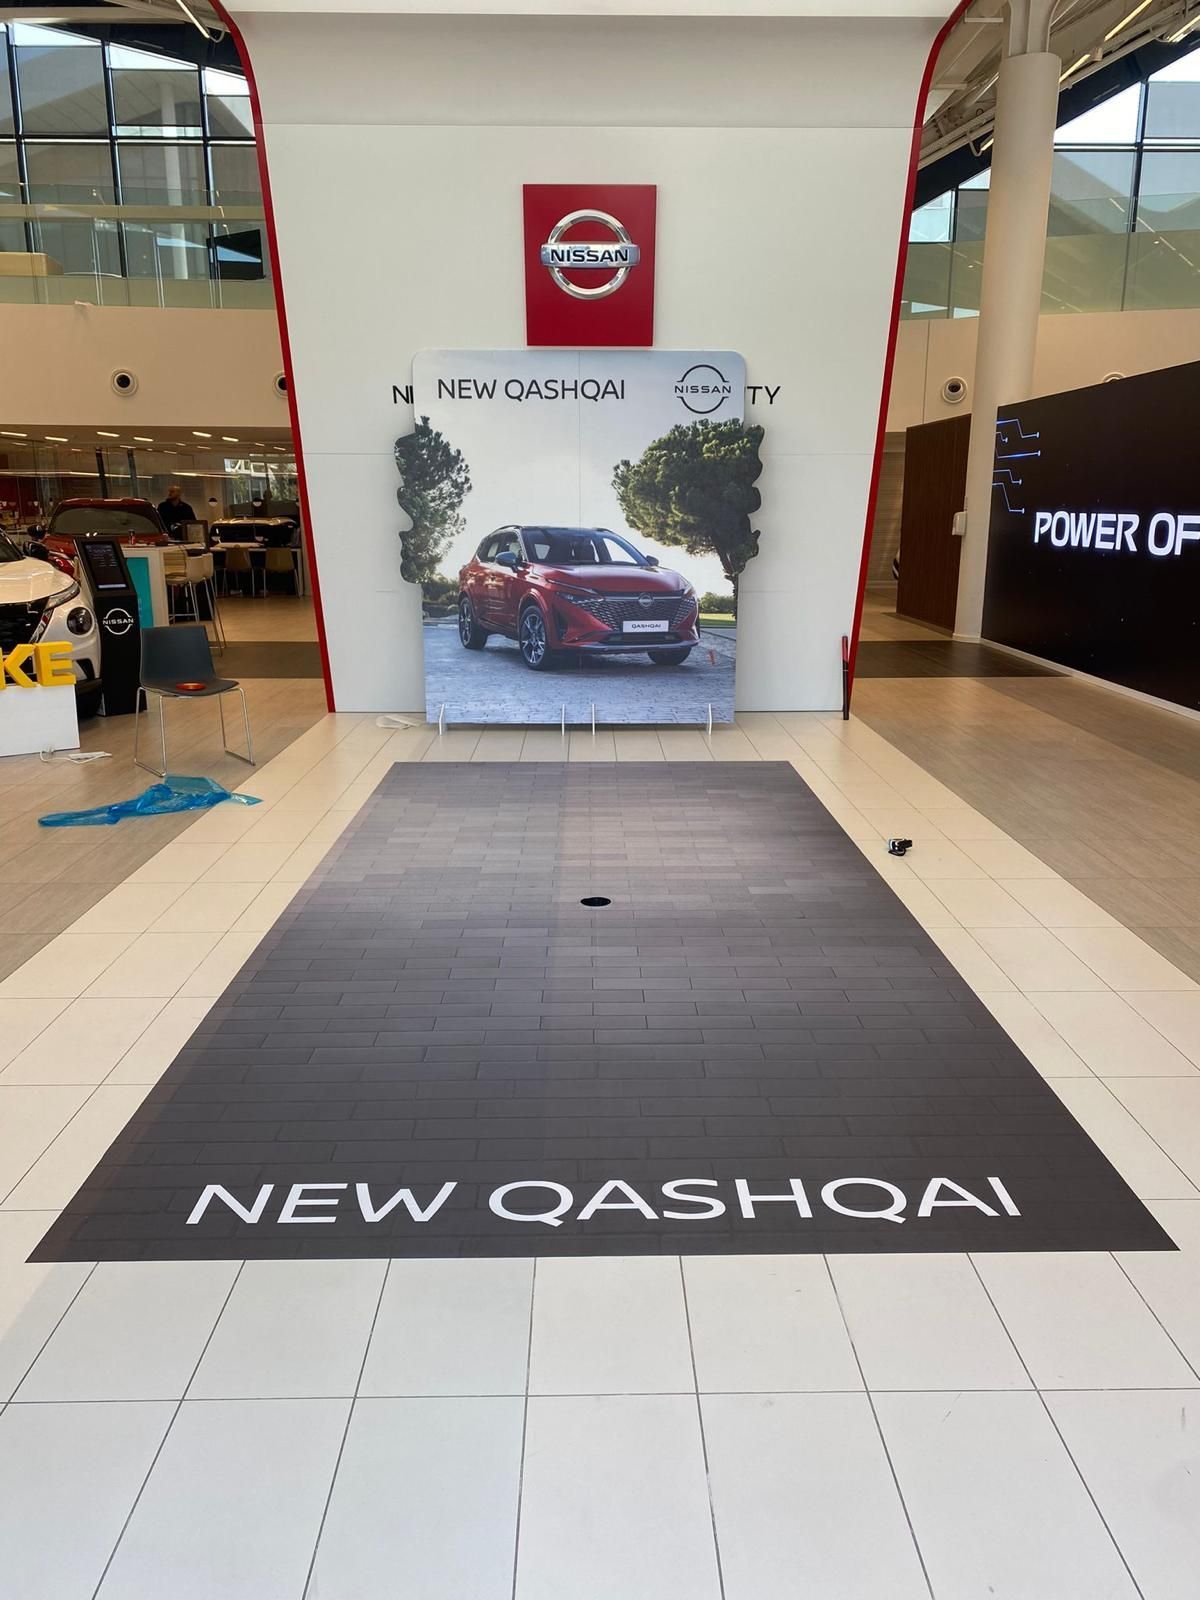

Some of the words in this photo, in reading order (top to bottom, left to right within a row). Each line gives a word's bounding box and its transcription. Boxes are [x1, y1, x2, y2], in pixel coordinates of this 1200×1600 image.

[550, 249, 629, 262] NISSAN
[437, 379, 497, 400] NEW
[504, 379, 625, 402] QASHQAI
[674, 385, 732, 394] NISSAN
[1034, 510, 1140, 552] POWER
[1148, 512, 1200, 556] OF
[185, 1181, 458, 1225] NEW
[488, 1177, 1021, 1227] QASHQAI
